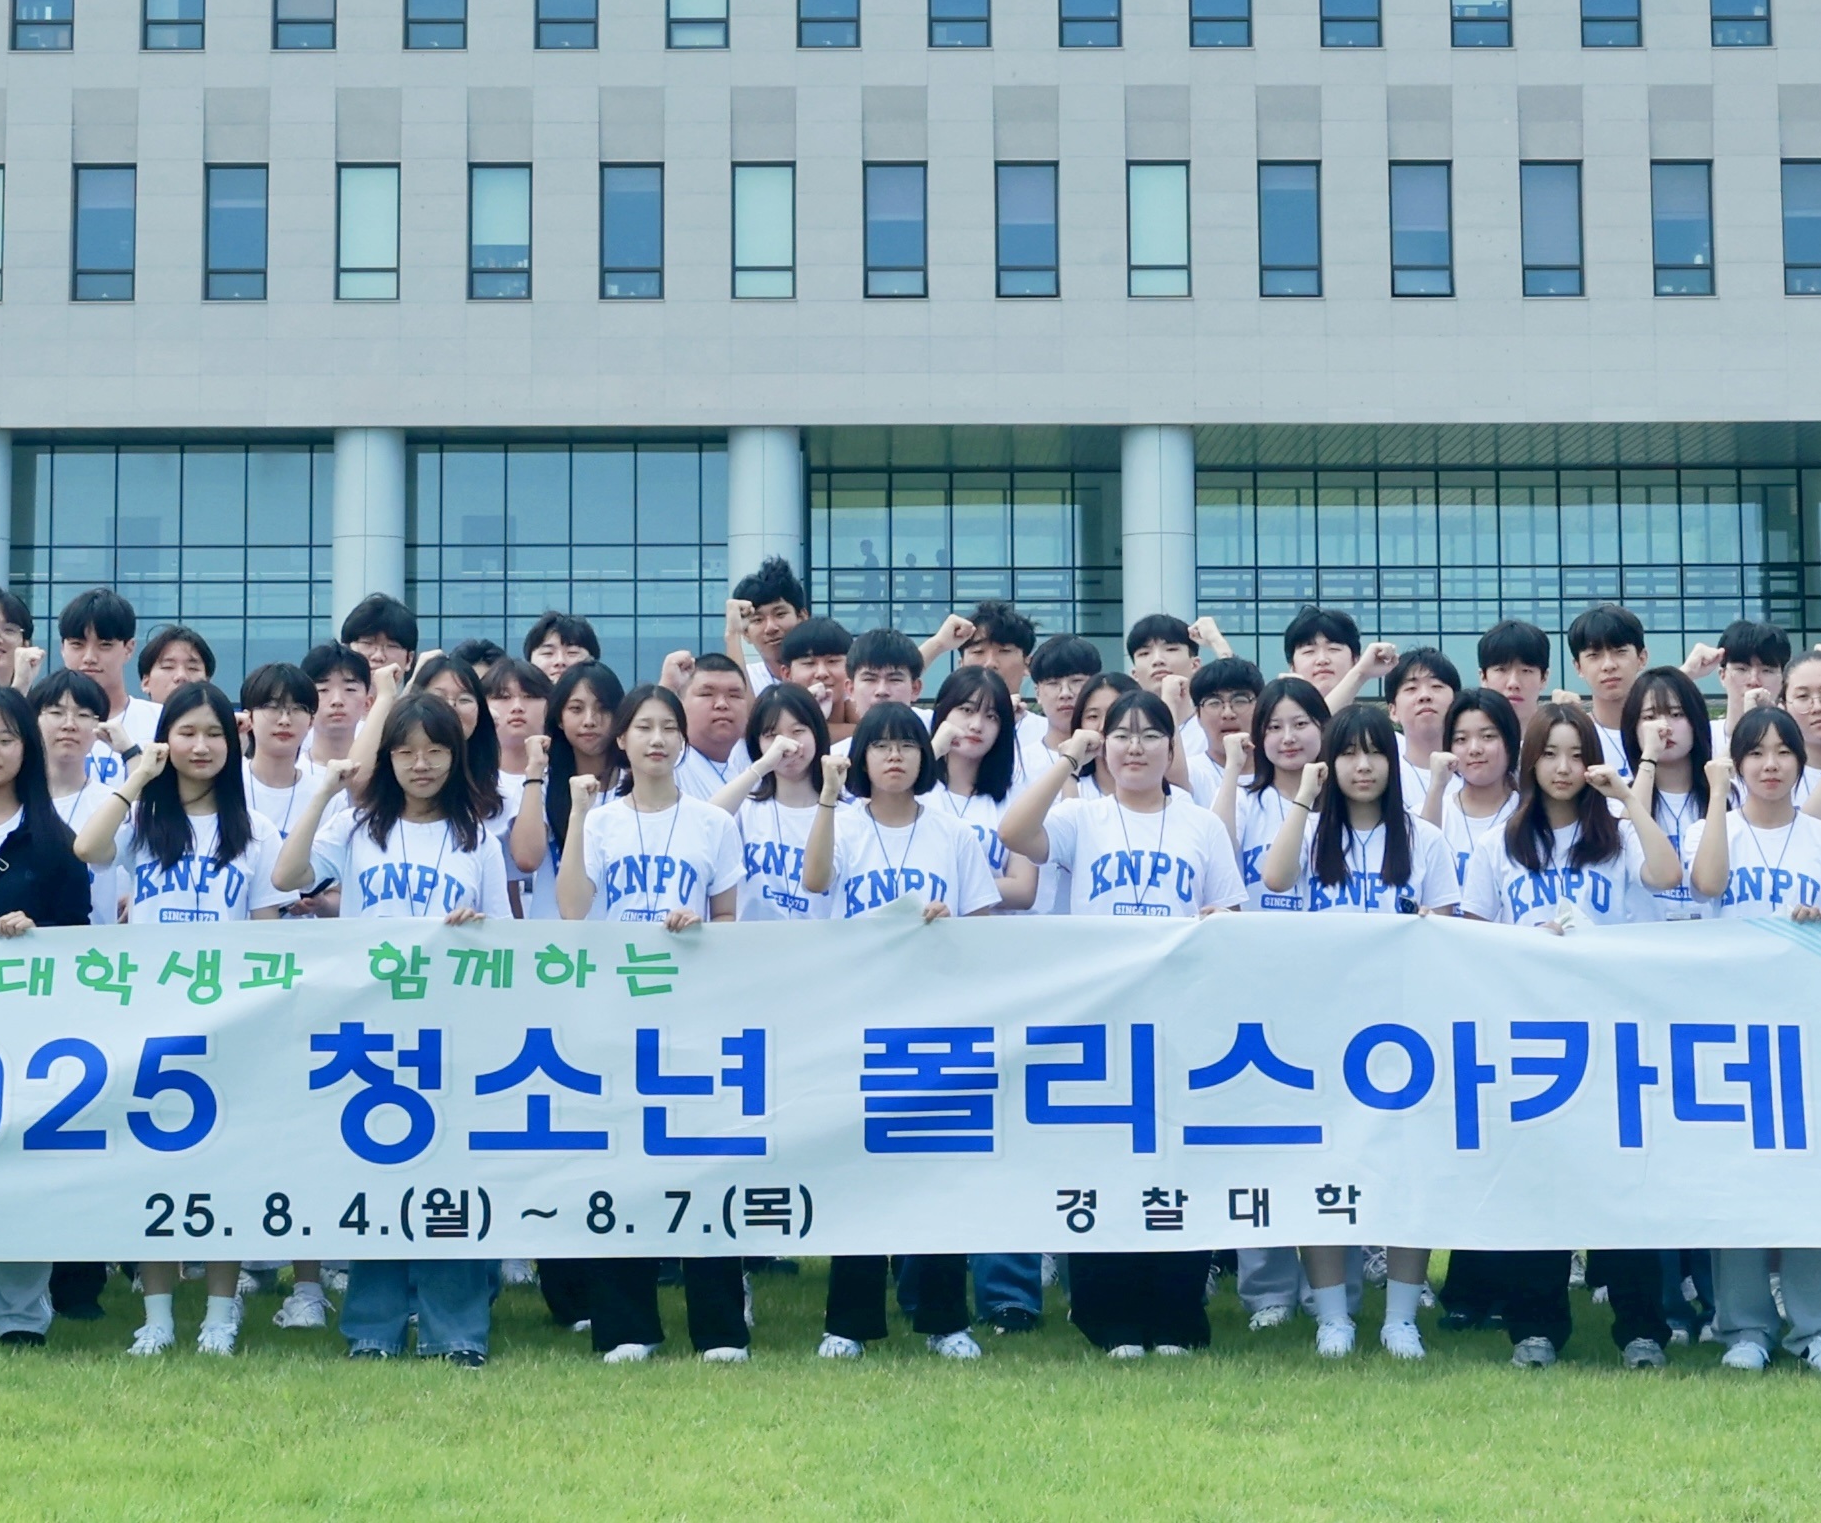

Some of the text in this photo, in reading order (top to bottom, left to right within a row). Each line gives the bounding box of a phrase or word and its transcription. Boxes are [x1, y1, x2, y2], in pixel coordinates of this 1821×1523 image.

[133, 855, 244, 908] KNPU
[359, 862, 465, 913] KNPU
[607, 855, 698, 912] KNPU
[743, 842, 805, 882] KNP
[1090, 850, 1195, 903] KNPU
[162, 911, 190, 922] SINCE
[1115, 904, 1168, 917] SINCE 1979
[1264, 896, 1292, 908] SINCE
[1507, 866, 1612, 923] KNPU
[369, 942, 678, 1001] 함께하는
[309, 1021, 767, 1165] 청소년
[145, 1192, 232, 1238] 25.
[263, 1192, 311, 1237] 8.
[586, 1190, 633, 1235] 8.
[1056, 1183, 1362, 1233] 경찰대학
